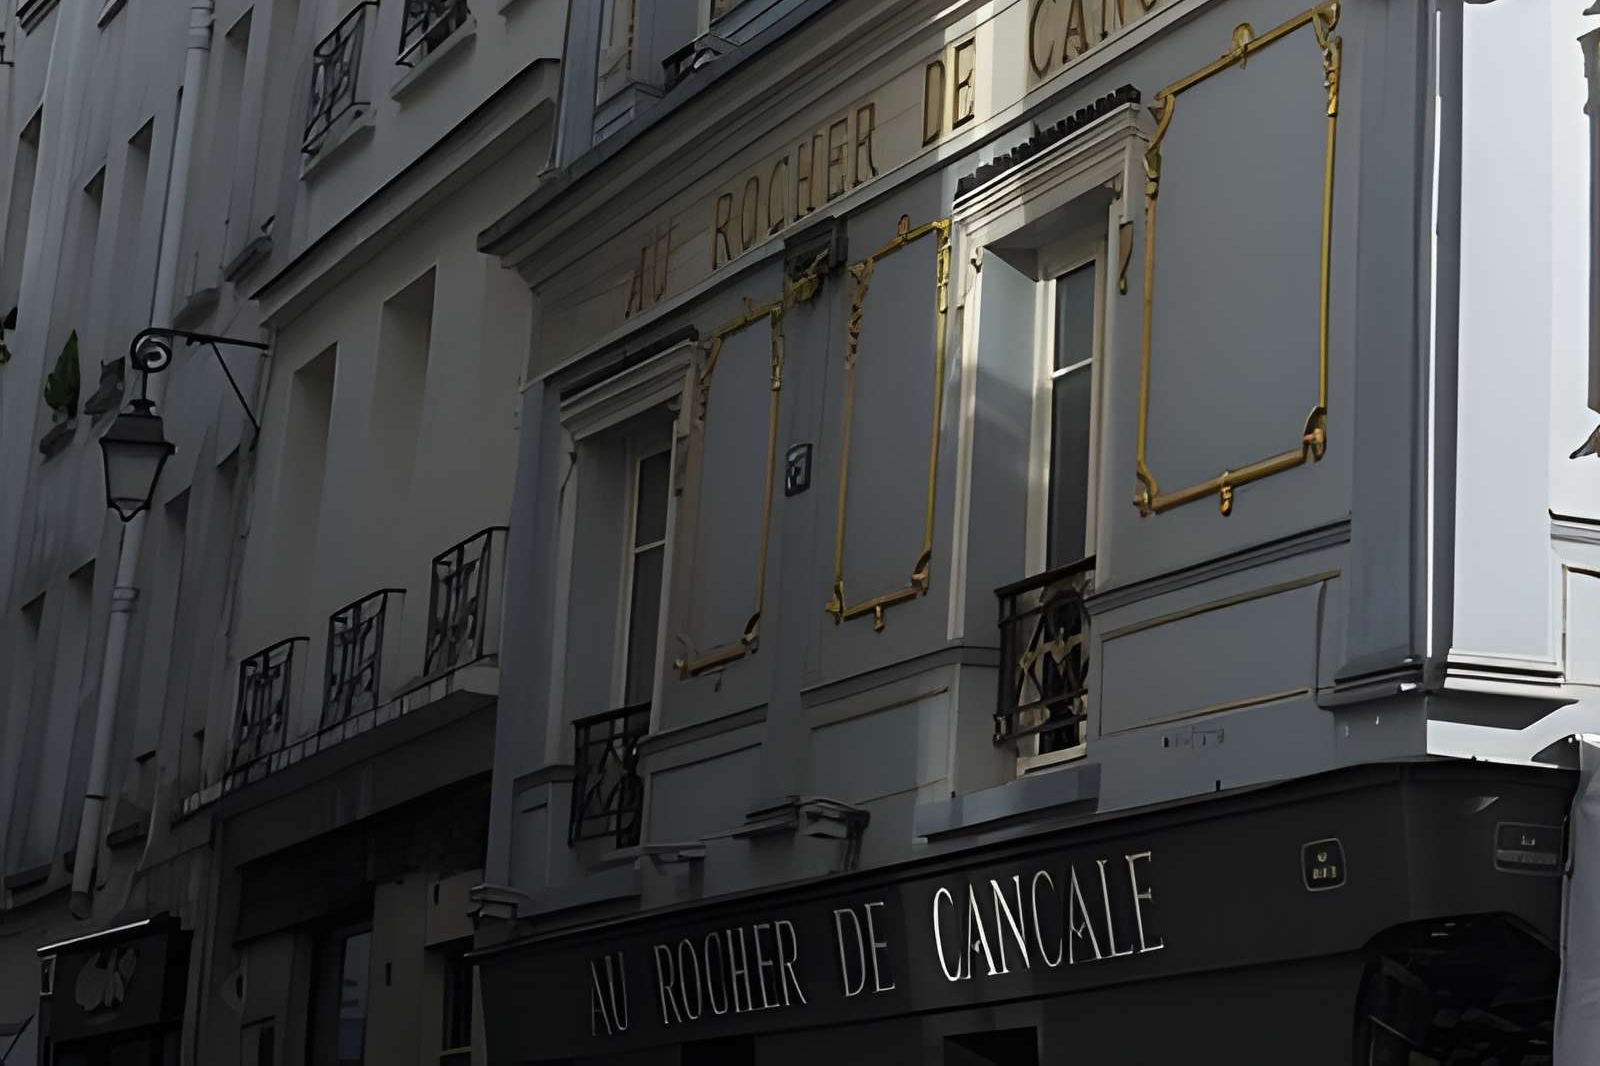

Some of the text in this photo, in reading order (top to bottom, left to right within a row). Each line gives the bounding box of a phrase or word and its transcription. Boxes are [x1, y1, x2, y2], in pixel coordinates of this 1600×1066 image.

[711, 102, 879, 270] ROCHER
[922, 37, 977, 147] DE
[589, 850, 1165, 1036] AU ROCHER DE CANCALE
